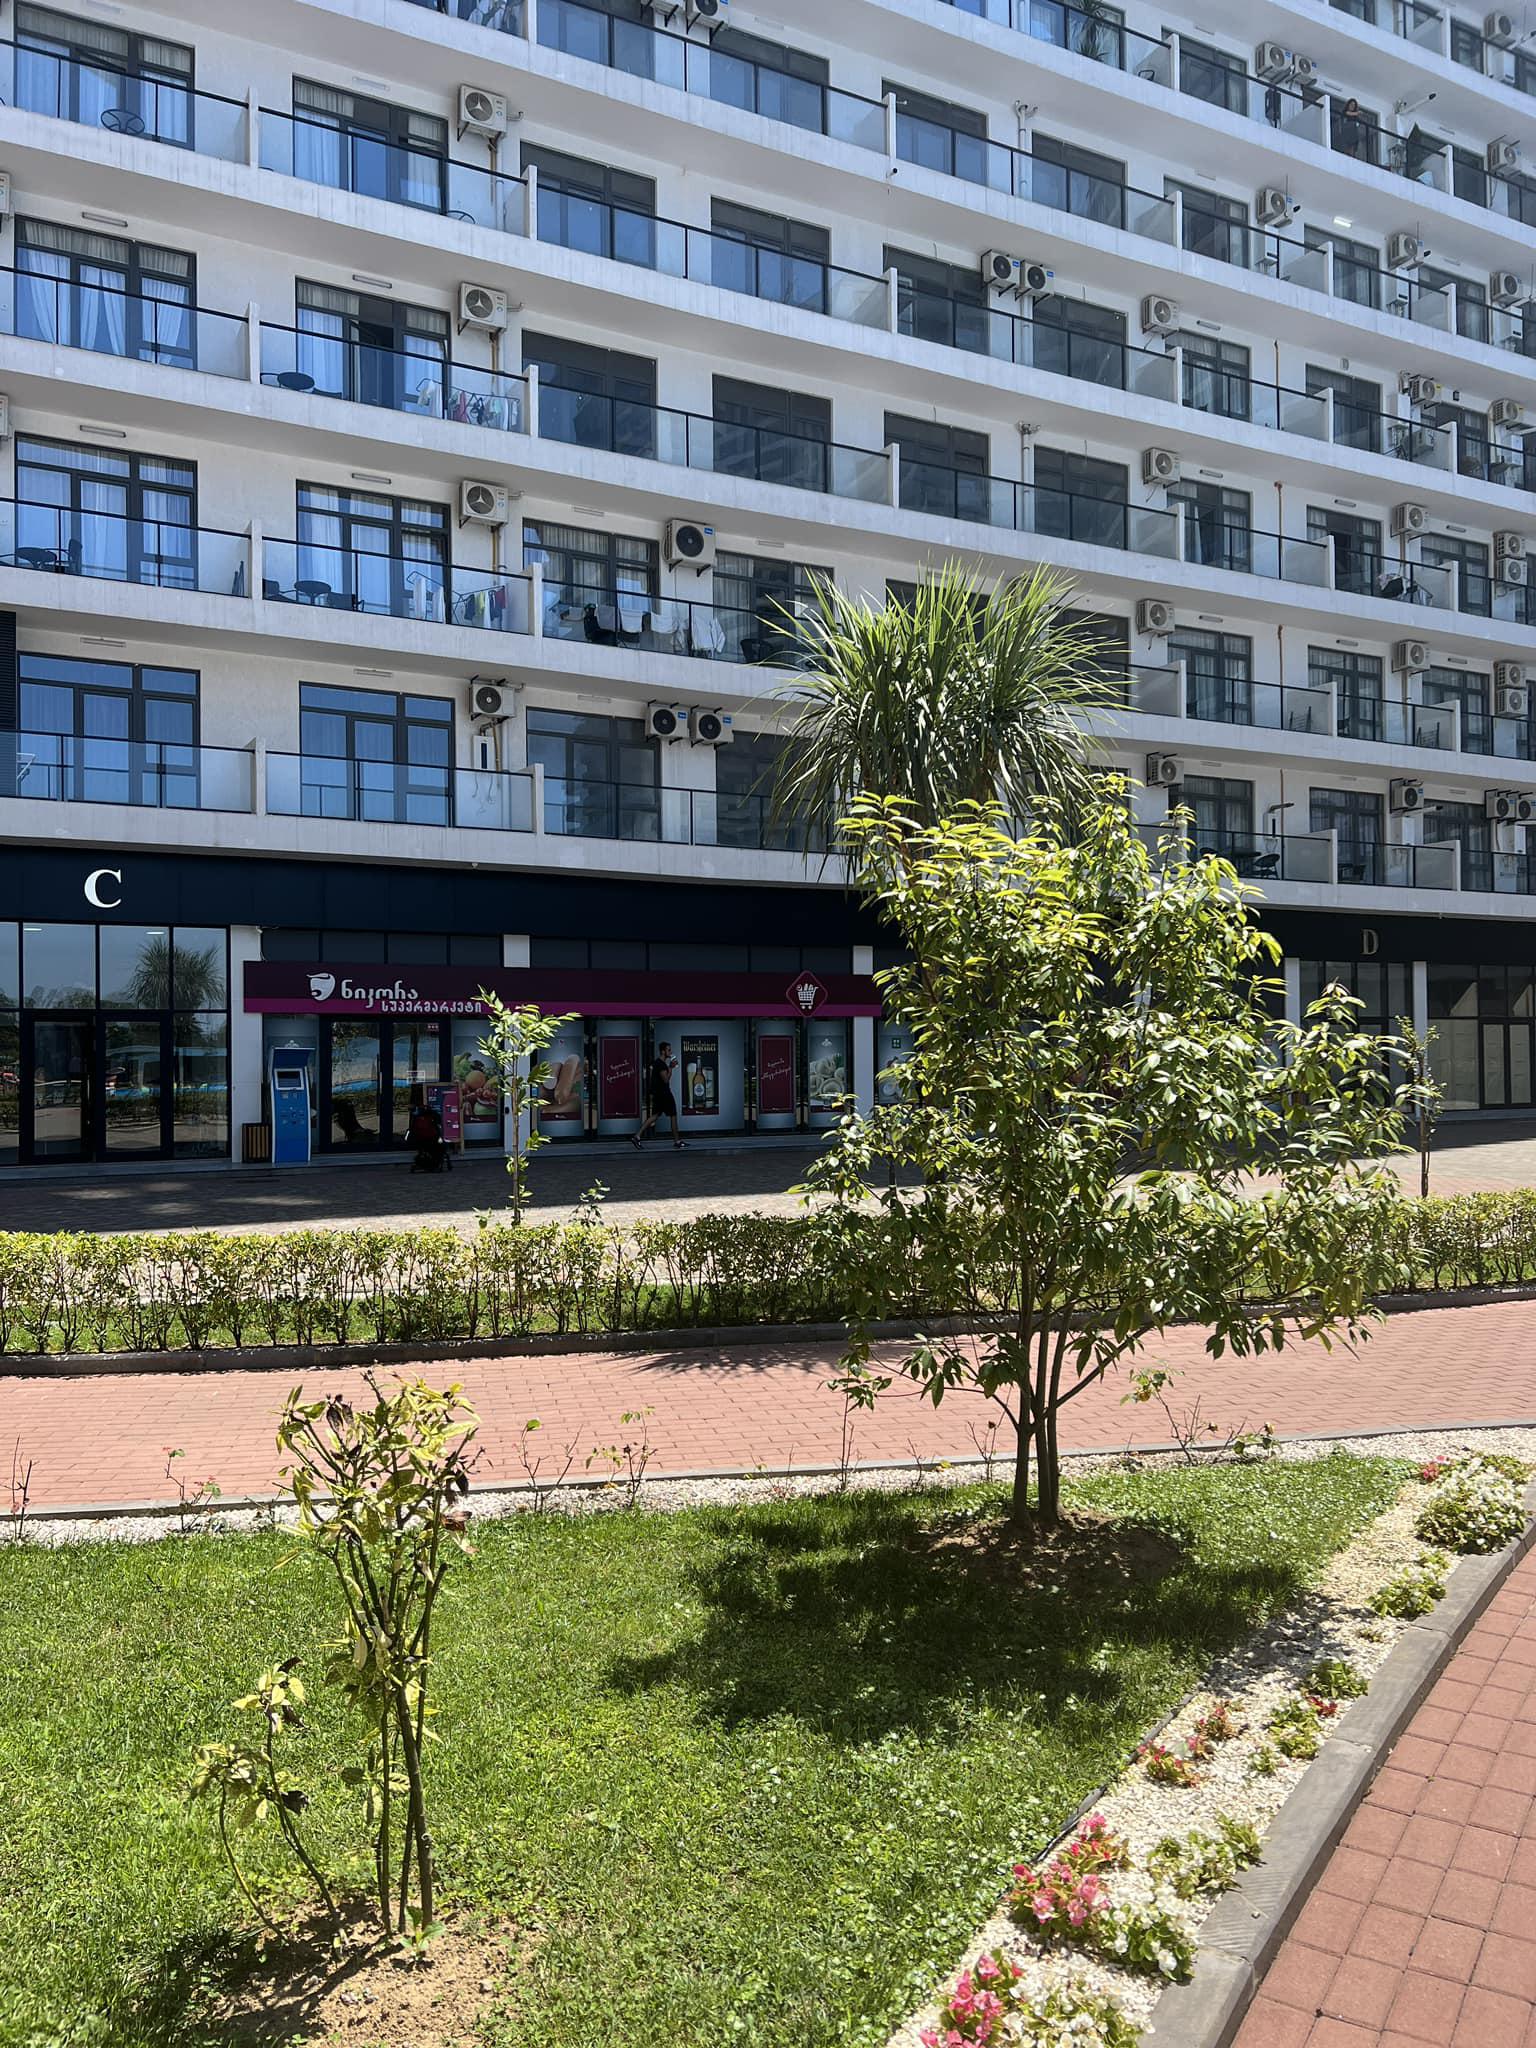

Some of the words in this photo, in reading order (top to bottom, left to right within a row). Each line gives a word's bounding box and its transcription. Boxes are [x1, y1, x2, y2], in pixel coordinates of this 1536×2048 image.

[84, 869, 122, 908] C
[1361, 928, 1380, 955] D
[341, 979, 418, 1008] ნიკორა
[381, 1001, 482, 1013] სუპერმარკეტი
